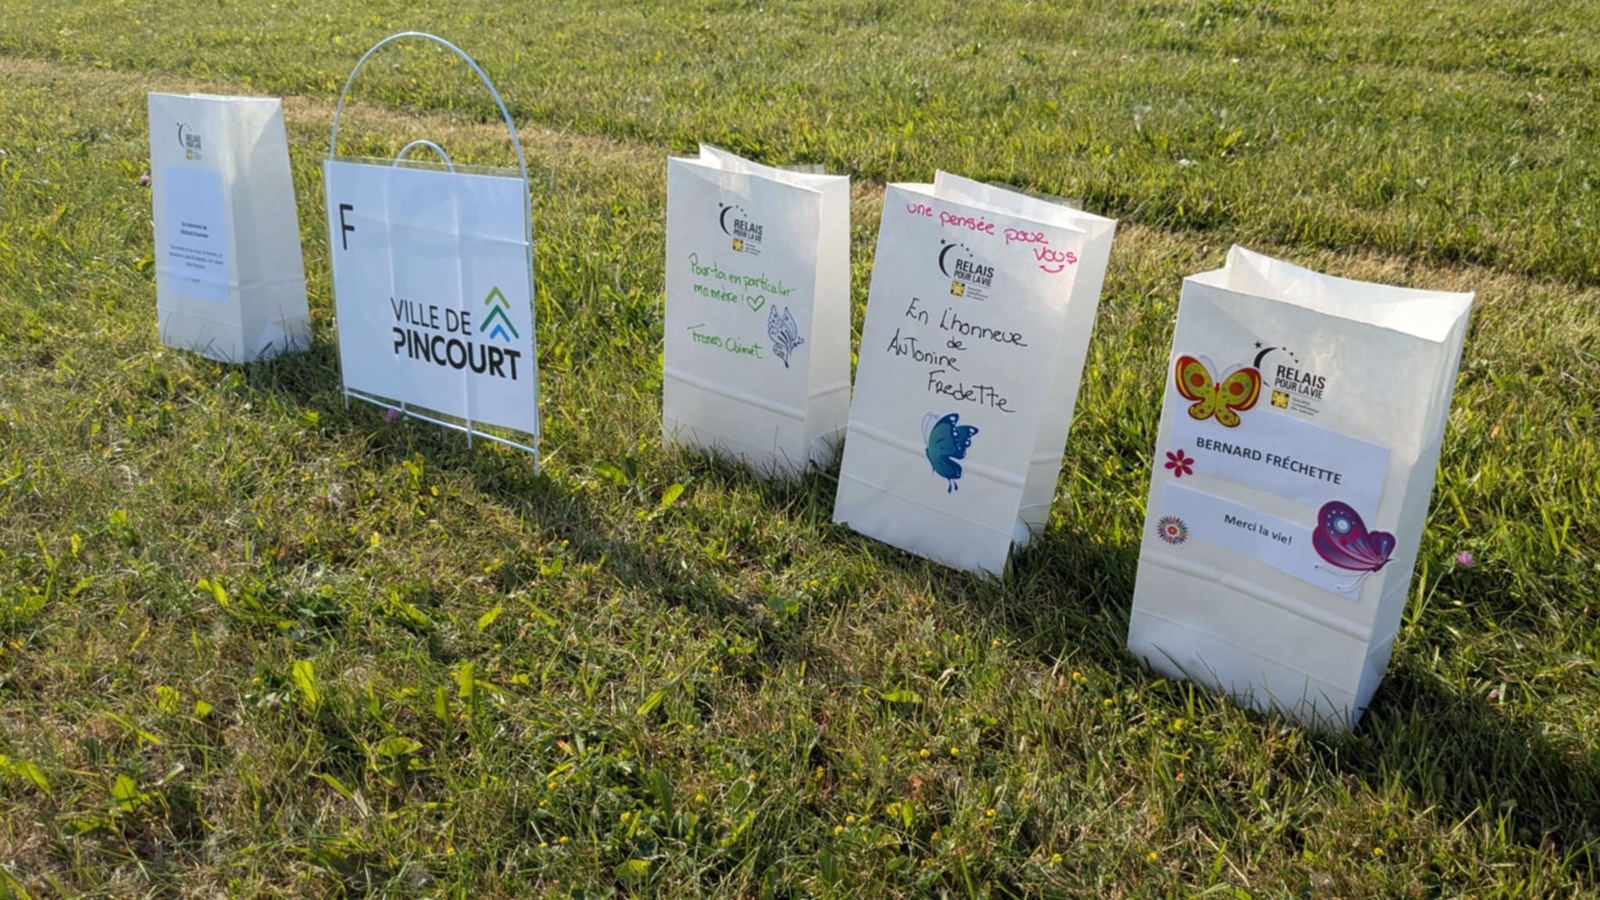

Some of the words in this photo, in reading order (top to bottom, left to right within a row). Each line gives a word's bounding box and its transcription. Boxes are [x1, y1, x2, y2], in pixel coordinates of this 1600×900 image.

[339, 203, 355, 250] F
[733, 218, 763, 236] RELAIS
[939, 211, 995, 236] pensée
[955, 258, 995, 279] RELAIS
[972, 275, 982, 285] LA
[390, 297, 440, 330] VILLE
[445, 308, 472, 336] DE
[905, 297, 929, 326] En
[392, 326, 521, 381] PINCOURT
[946, 335, 967, 351] de
[1274, 377, 1298, 393] POUR
[1298, 384, 1311, 397] LA
[1309, 387, 1325, 400] VIE
[1276, 364, 1326, 391] RELAIS
[1196, 436, 1263, 461] BERNARD
[1265, 452, 1343, 485] FRÉCHETTE
[1224, 513, 1257, 532] Merci
[1258, 523, 1270, 537] la
[1270, 530, 1293, 546] vie!
